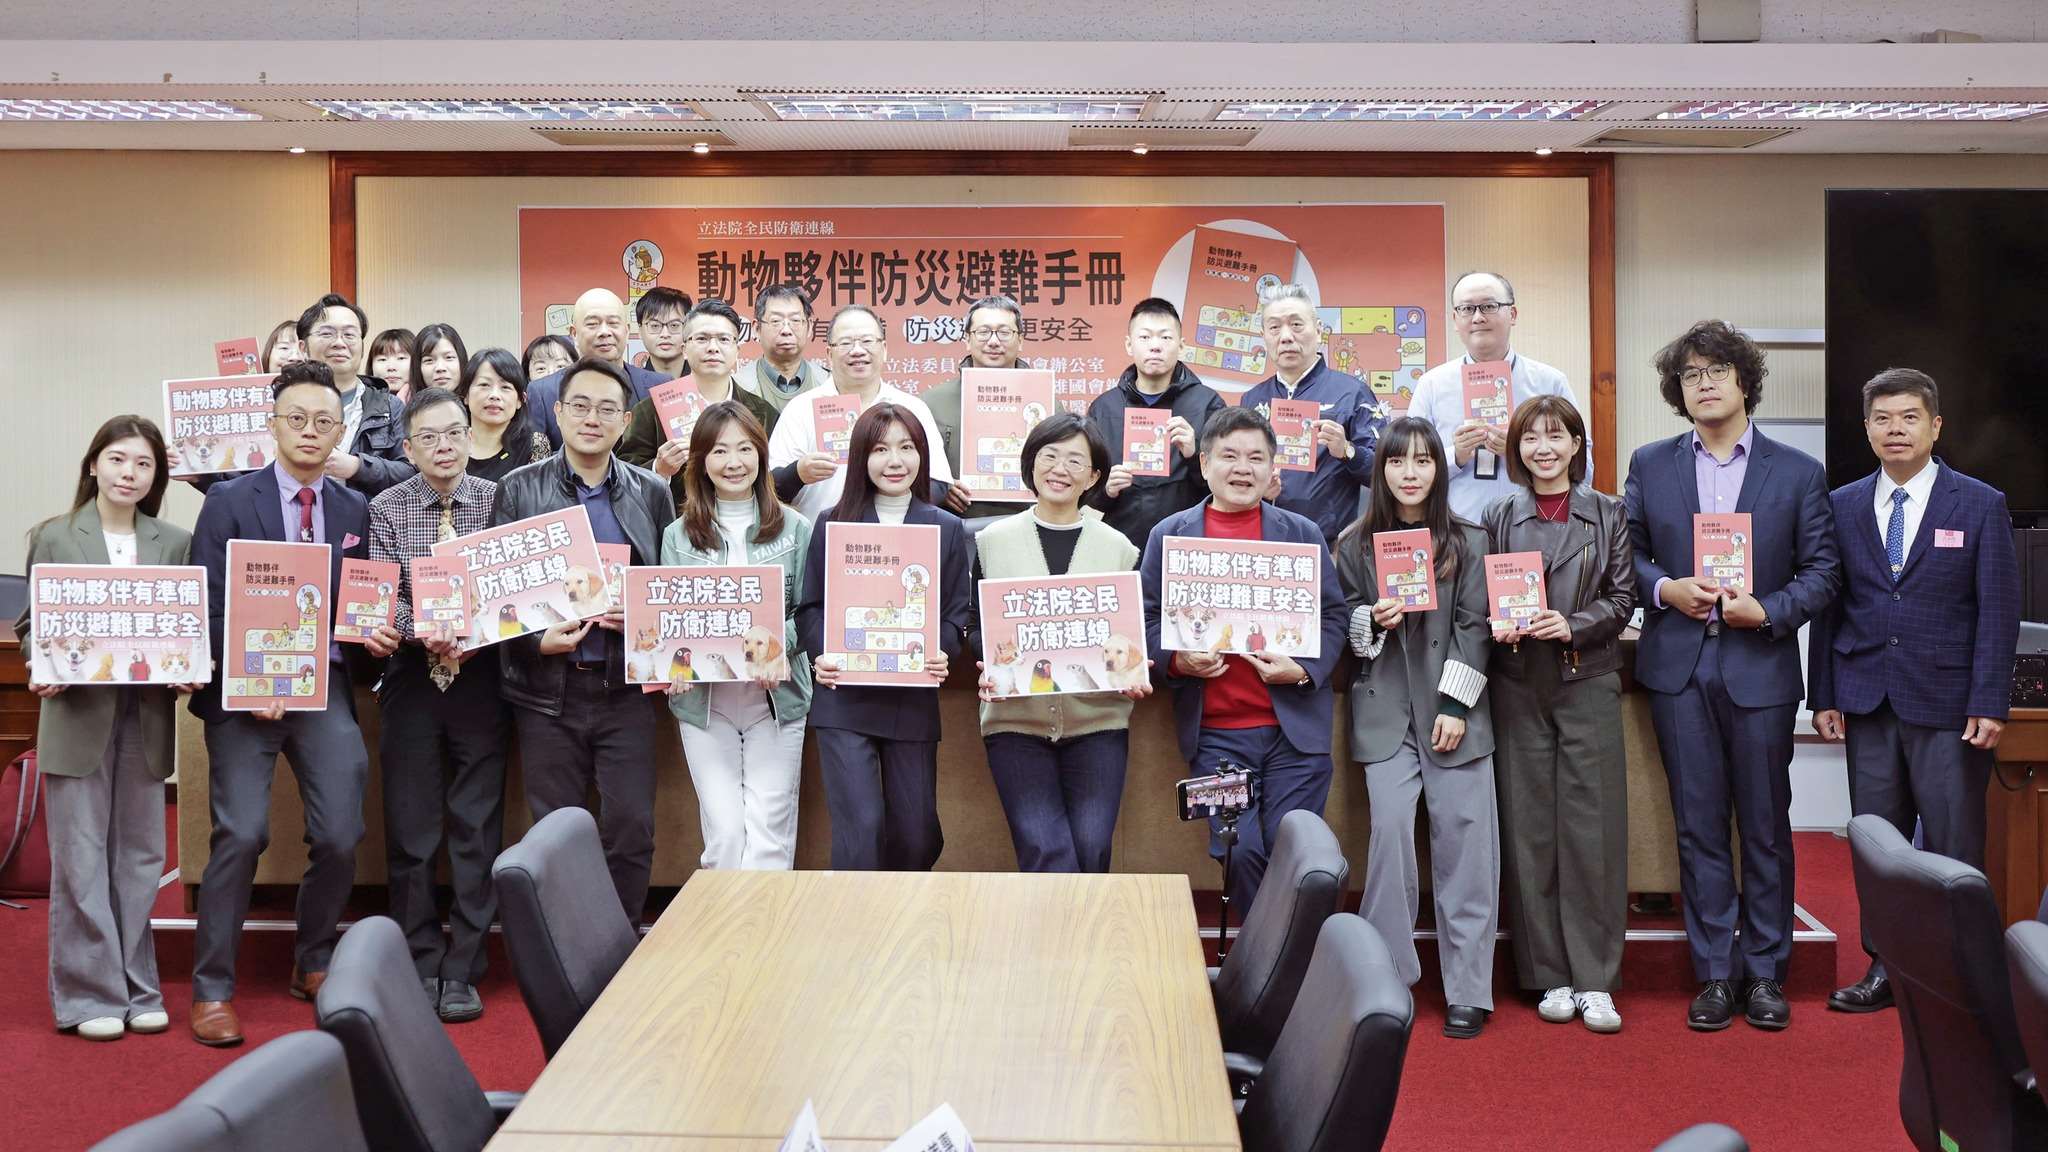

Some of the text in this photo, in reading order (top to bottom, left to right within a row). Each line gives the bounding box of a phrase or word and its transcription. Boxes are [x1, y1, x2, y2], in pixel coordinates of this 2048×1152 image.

[697, 220, 835, 236] 立法院全民防衛連線
[697, 248, 1126, 307] 動物夥伴防災避難手冊
[905, 316, 1094, 343] 防災更安全
[456, 520, 572, 572] 立法院全民
[844, 555, 901, 566] 防災避難手冊
[845, 543, 883, 553] 動物夥伴
[245, 574, 296, 586] 防災避難手冊
[246, 562, 280, 573] 動物夥伴
[475, 553, 569, 602] 防衛連線
[1167, 549, 1316, 583] 動物夥伴有準備
[37, 578, 201, 606] 動物夥伴有準備
[646, 576, 763, 606] 立法院全民
[1002, 584, 1120, 619] 立法院全民
[1167, 581, 1316, 614] 防災避難更安全
[38, 612, 202, 639] 防災避難更安全
[659, 608, 753, 640] 防衛連線
[1016, 618, 1112, 652] 防衛連線
